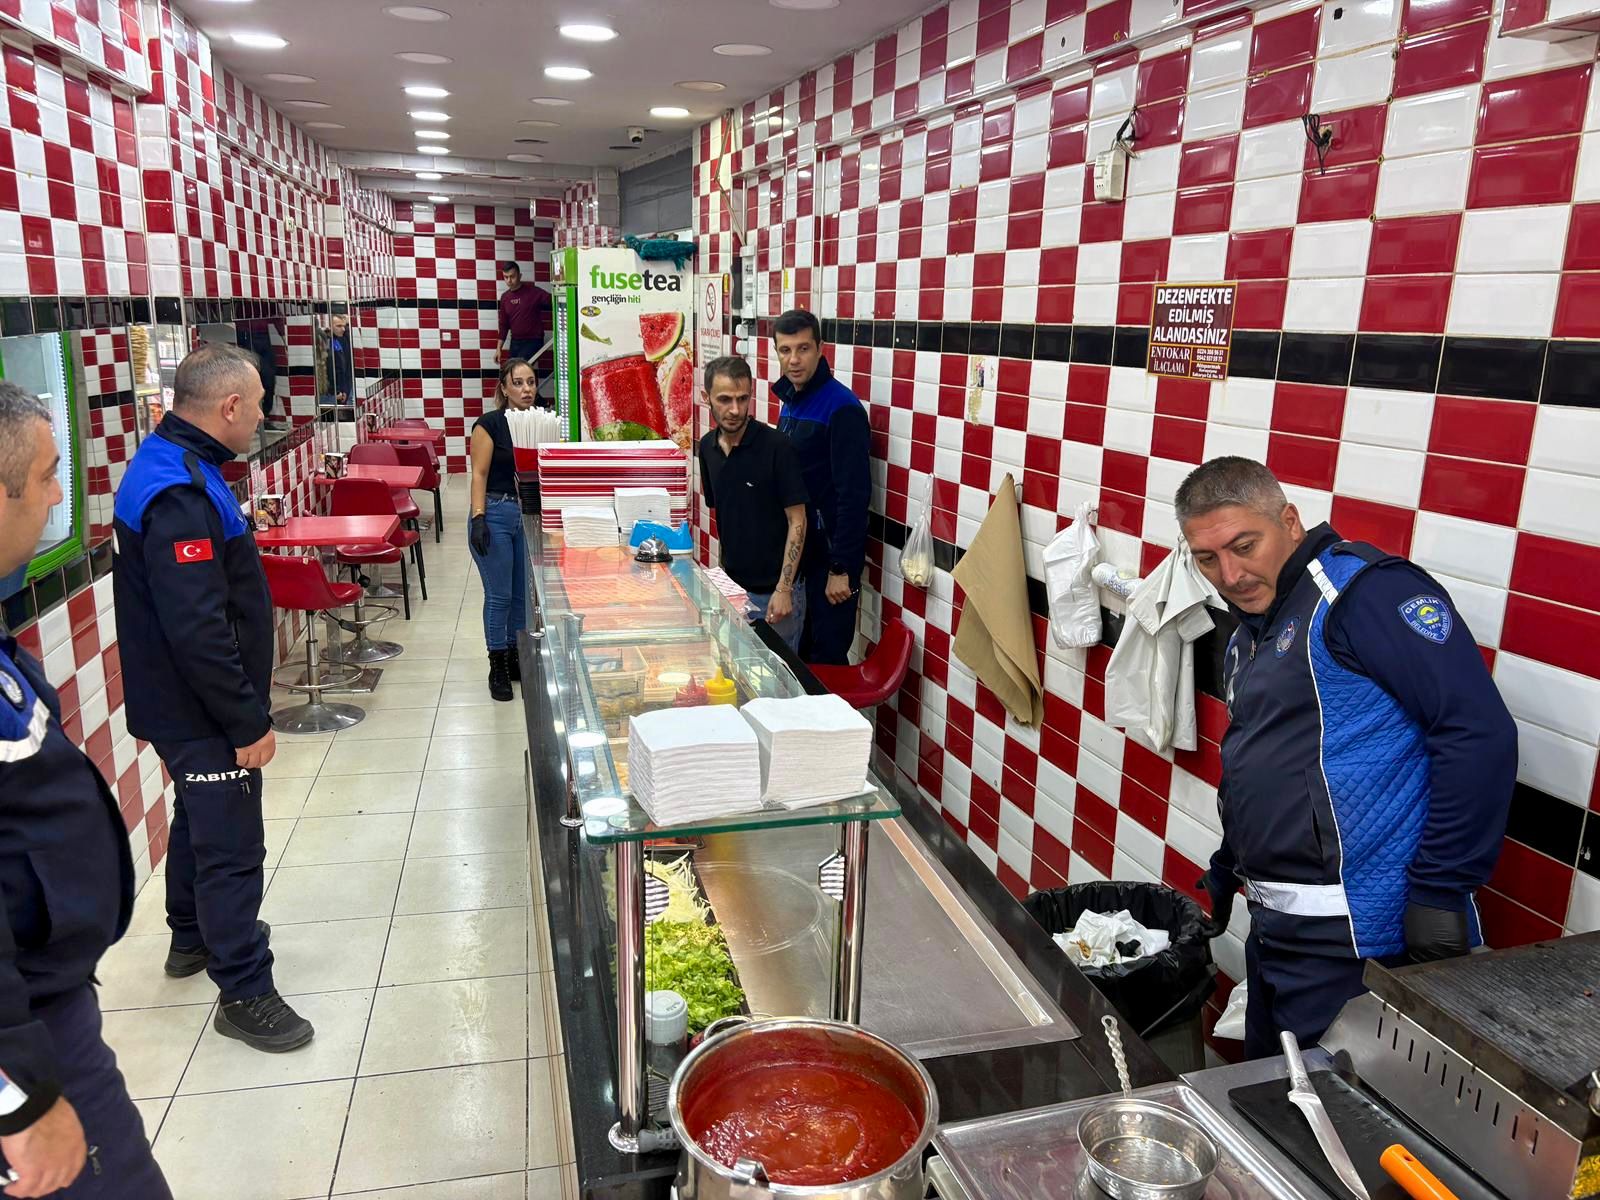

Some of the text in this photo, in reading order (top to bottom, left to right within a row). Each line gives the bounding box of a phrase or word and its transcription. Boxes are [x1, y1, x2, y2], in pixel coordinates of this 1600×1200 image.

[590, 265, 681, 291] fusetea
[591, 294, 641, 305] gençliğin hiti
[1157, 288, 1232, 304] DEZENFEKTE
[1168, 305, 1214, 326] EDİLMİŞ
[1153, 326, 1228, 345] ALANDASINIZ
[1151, 346, 1190, 360] ENTOKAR
[1153, 359, 1185, 374] İLAÇLAMA
[185, 768, 250, 782] ZABITA
